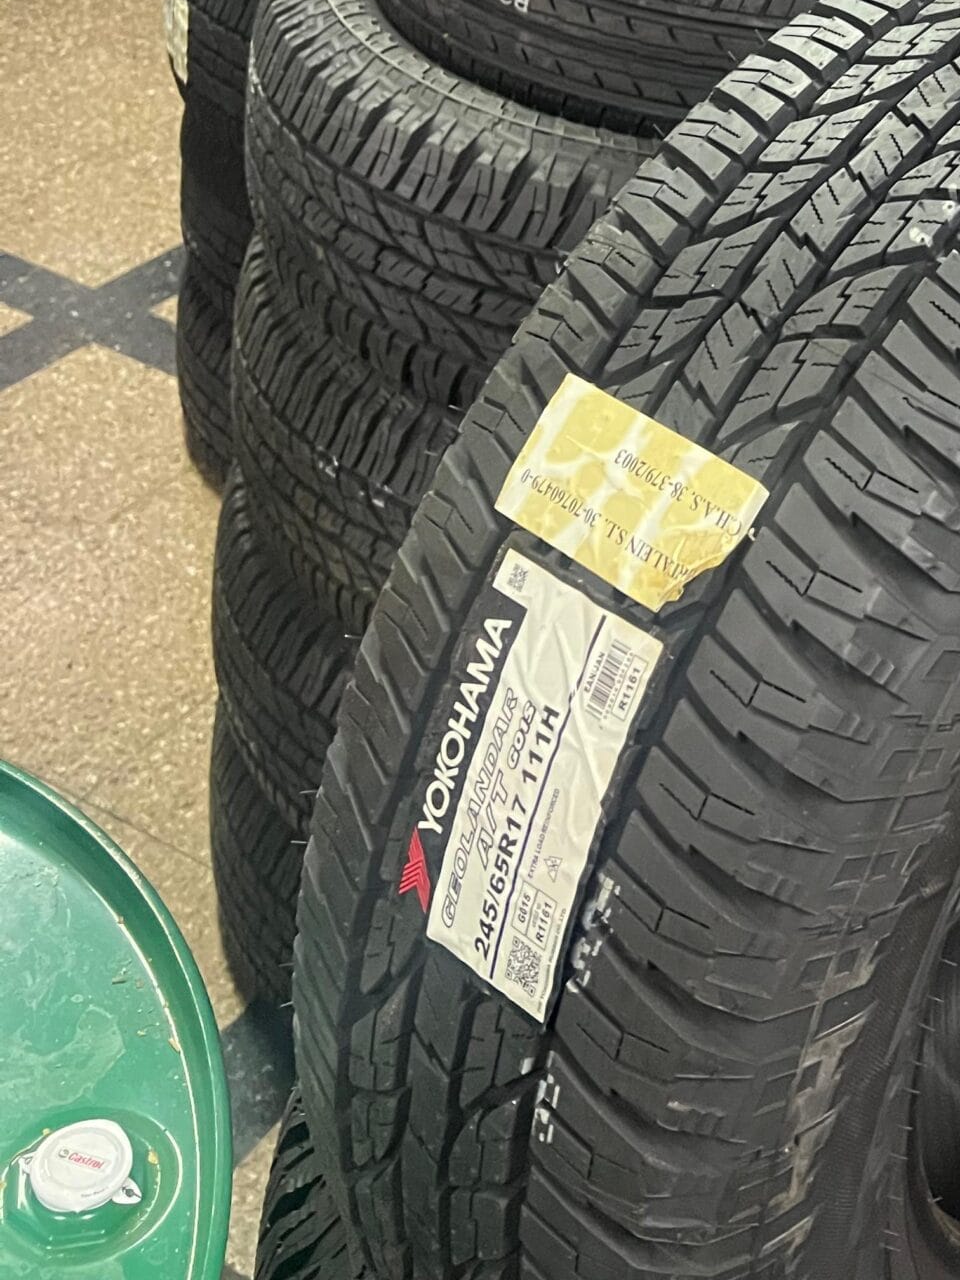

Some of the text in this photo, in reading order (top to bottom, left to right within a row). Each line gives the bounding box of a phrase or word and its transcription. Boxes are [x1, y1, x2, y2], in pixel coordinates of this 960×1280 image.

[614, 448, 689, 503] 38-379/2003
[618, 667, 641, 711] R1161
[418, 618, 512, 834] YOKOHAMA
[442, 687, 518, 929] GEOLANDAR
[474, 705, 560, 960] 245/65R17 111H
[477, 772, 508, 871] A/T
[528, 856, 541, 879] EXTRA
[518, 893, 531, 923] G015
[535, 901, 553, 943] R1161
[68, 1151, 104, 1169] Castrol
